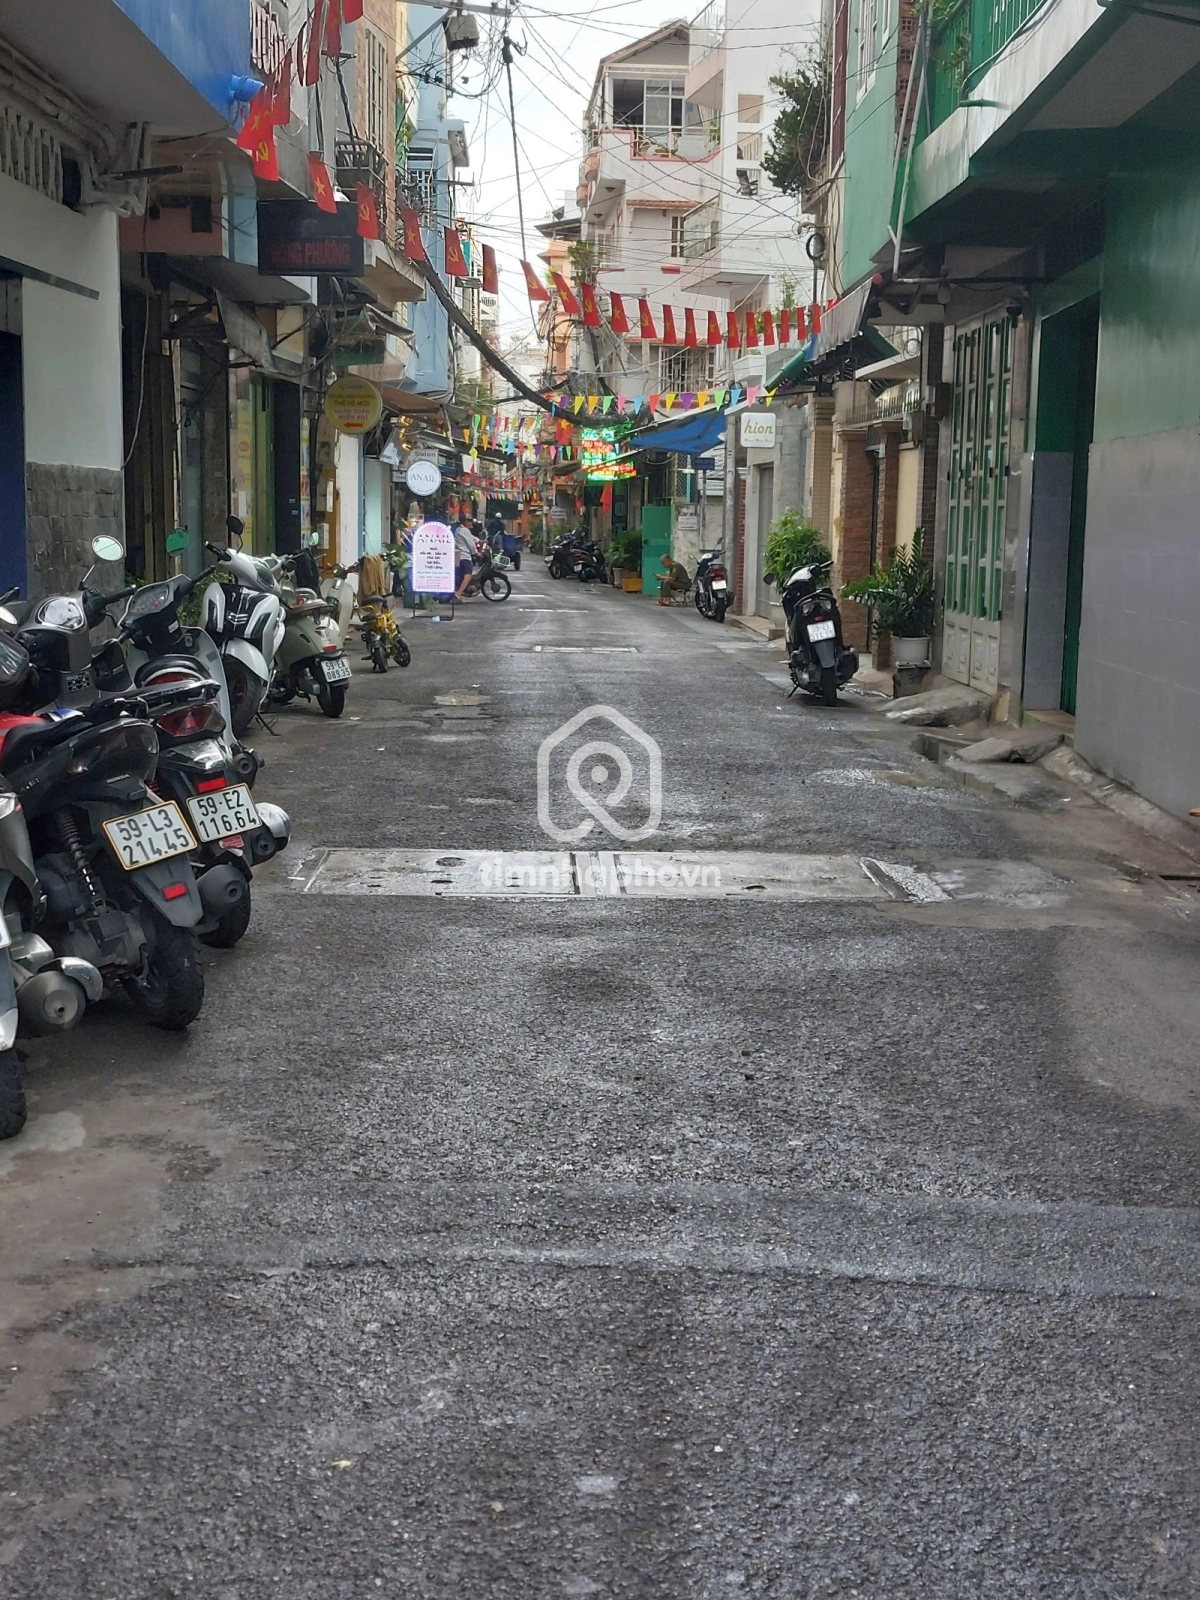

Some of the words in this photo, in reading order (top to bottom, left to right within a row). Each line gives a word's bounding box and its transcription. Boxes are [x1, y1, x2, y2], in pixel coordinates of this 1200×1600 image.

[744, 418, 773, 434] hion
[410, 473, 436, 483] ANAIL
[197, 789, 244, 817] 59-E2
[116, 809, 173, 841] 59-L3
[199, 808, 257, 838] 116.64
[123, 827, 190, 866] 214.45
